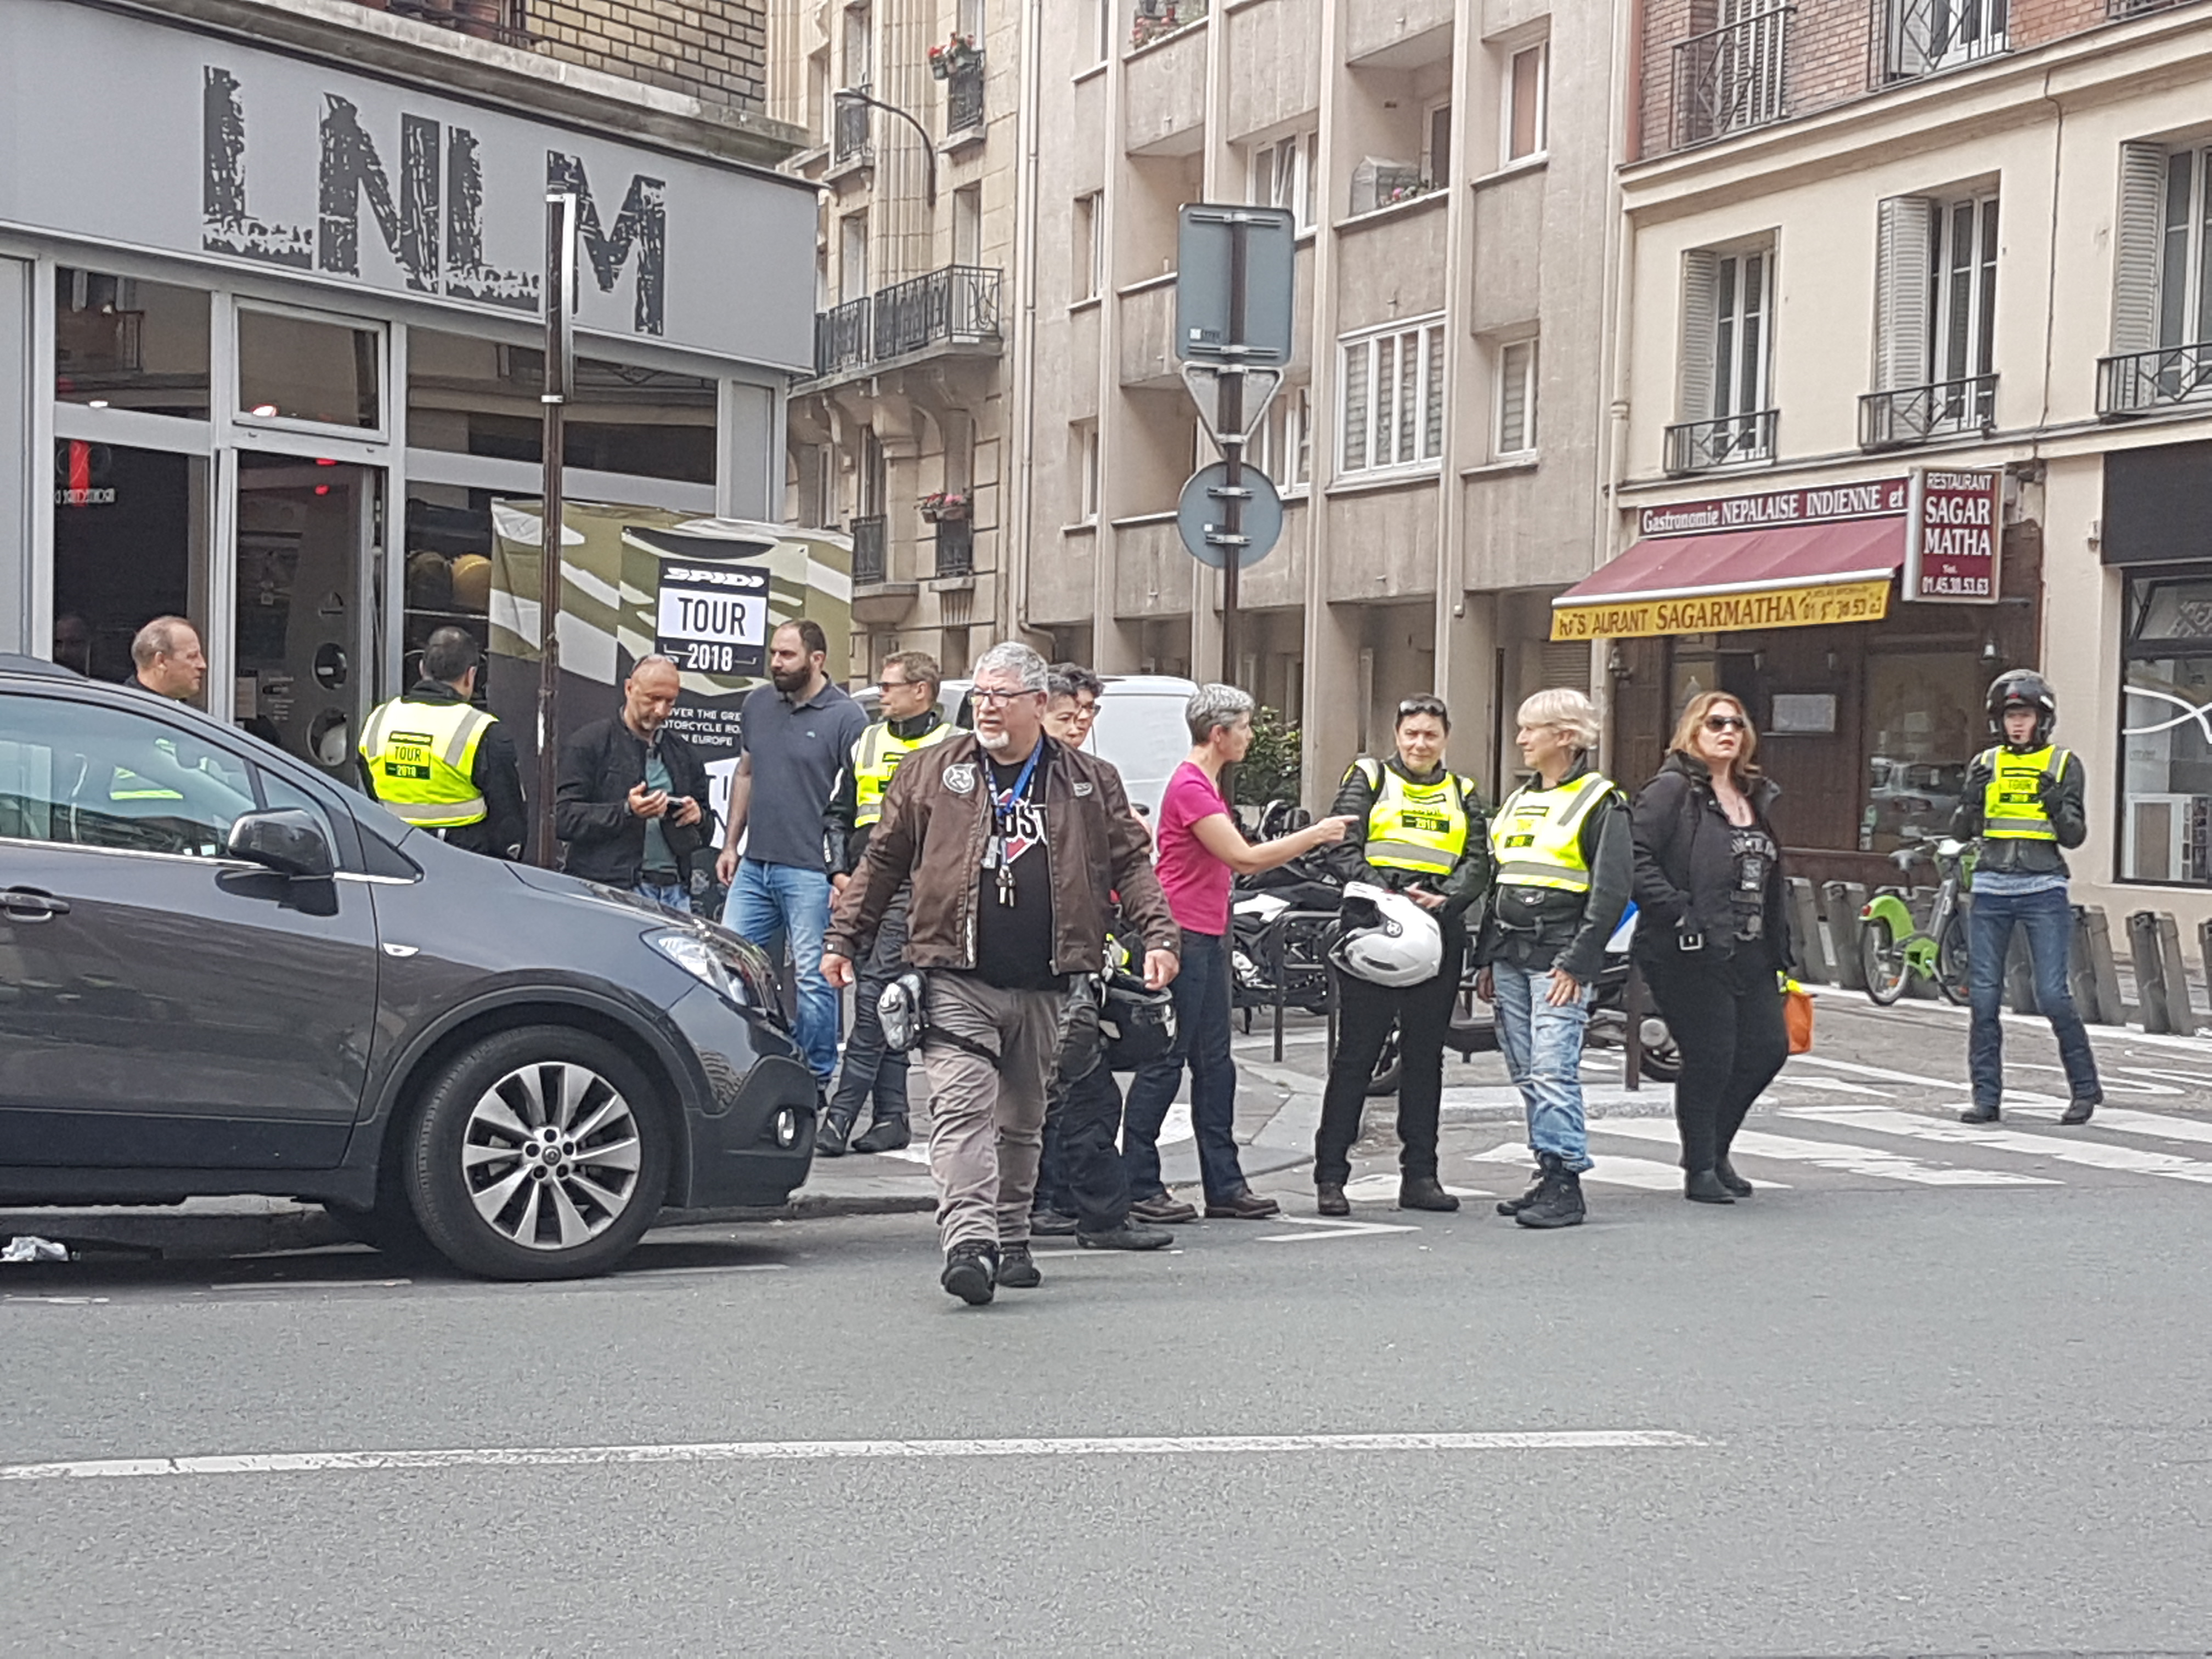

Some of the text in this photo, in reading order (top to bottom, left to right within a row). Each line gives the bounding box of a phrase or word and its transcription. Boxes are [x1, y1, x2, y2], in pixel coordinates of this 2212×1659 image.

[1926, 472, 1993, 490] RESTAURANT
[1643, 484, 1905, 533] Gastronomie NEPALAISE INDIENNE et
[1925, 496, 1990, 525] SAGAR
[1923, 528, 1992, 556] MATHA
[678, 597, 746, 637] TOUR
[1656, 596, 1796, 631] SAGARMATHA
[686, 643, 733, 672] 2018
[697, 708, 718, 720] THE
[395, 746, 421, 762] TOUR
[691, 733, 733, 747] EUROPE
